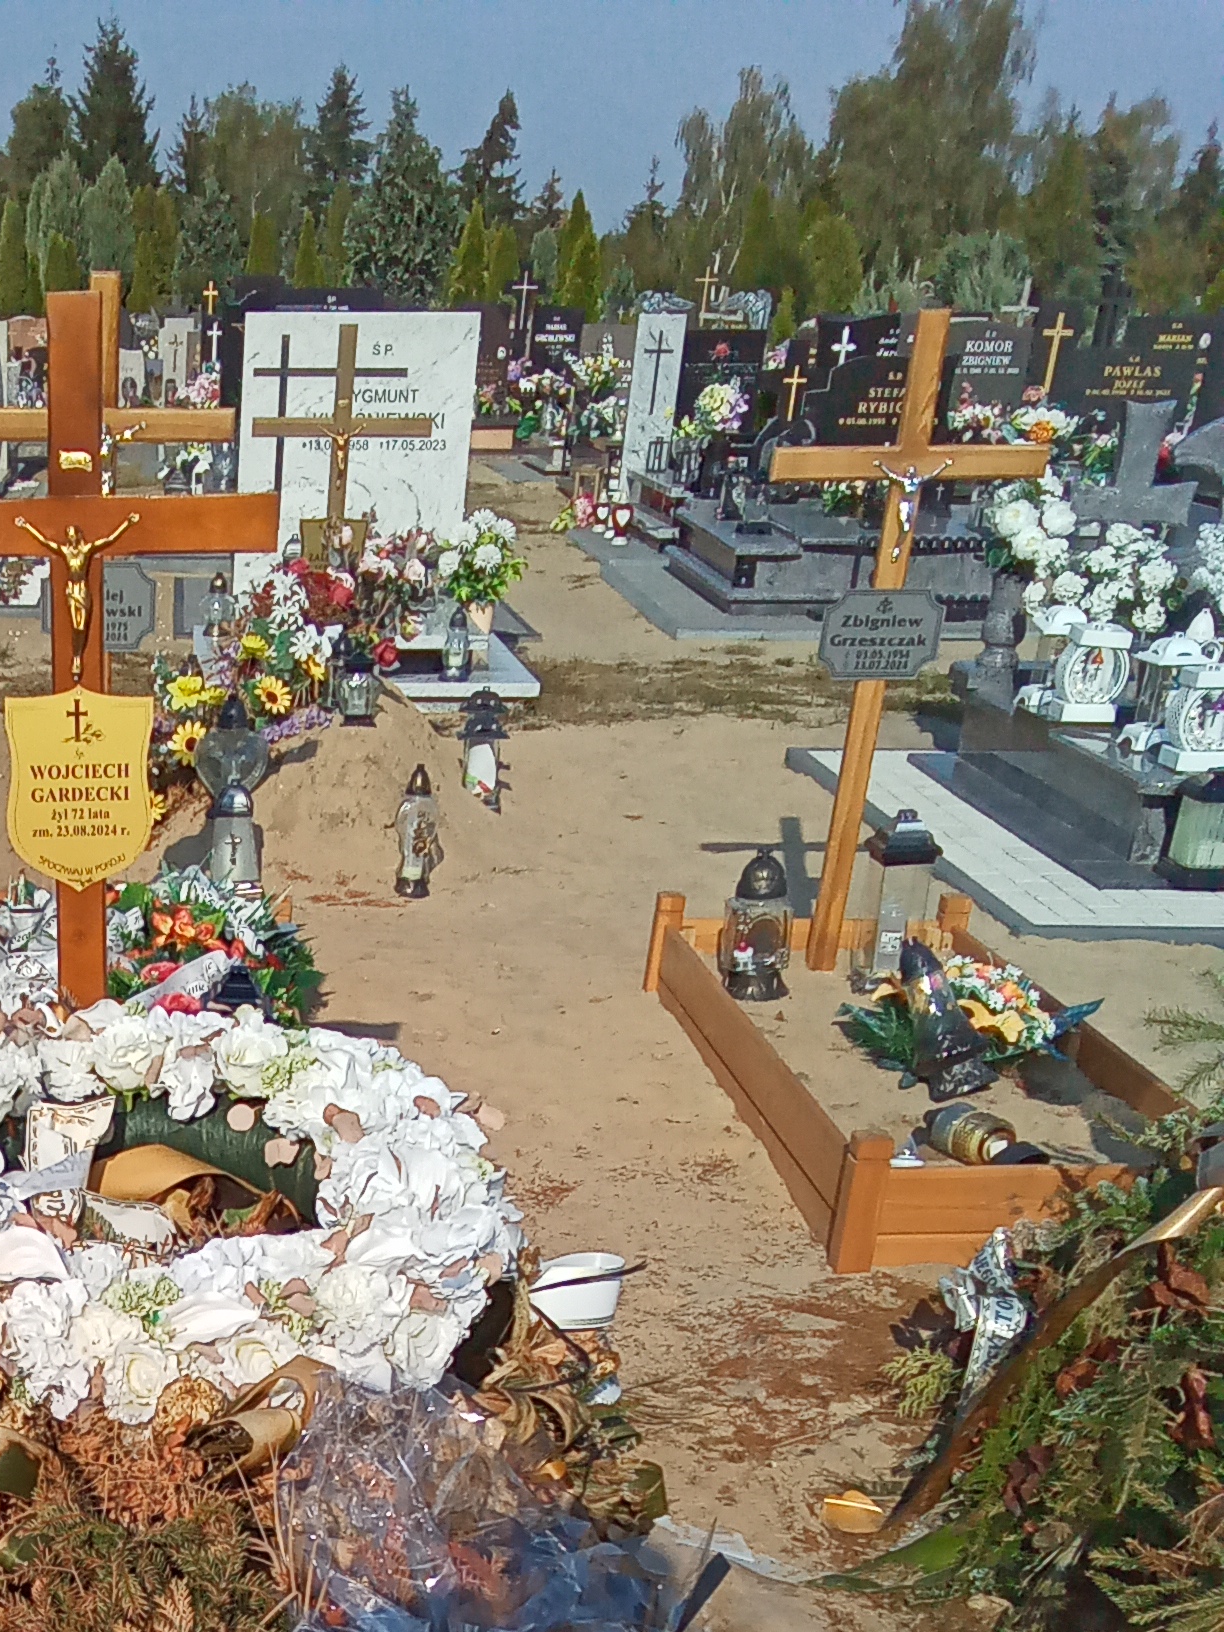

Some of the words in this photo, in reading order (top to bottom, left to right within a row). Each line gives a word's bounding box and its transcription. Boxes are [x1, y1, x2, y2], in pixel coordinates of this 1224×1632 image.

[965, 340, 1013, 352] KOMOR
[961, 355, 1012, 365] ZBIGNIEW
[1103, 365, 1162, 377] PAWLAS
[352, 388, 419, 404] YGMUNT
[840, 614, 924, 631] Zbigniew
[829, 633, 927, 647] Grzeszczak
[29, 763, 130, 780] WOJCIECH
[30, 786, 130, 803] GARDECKI
[51, 808, 68, 823] żył
[71, 808, 85, 820] 72
[88, 808, 110, 820] lata
[32, 827, 53, 838] zm.
[56, 825, 117, 837] 23.08.2024
[120, 826, 130, 836] r.
[38, 855, 84, 876] SPOCZYWAJ
[85, 866, 93, 875] W
[94, 852, 127, 872] POKOJU
